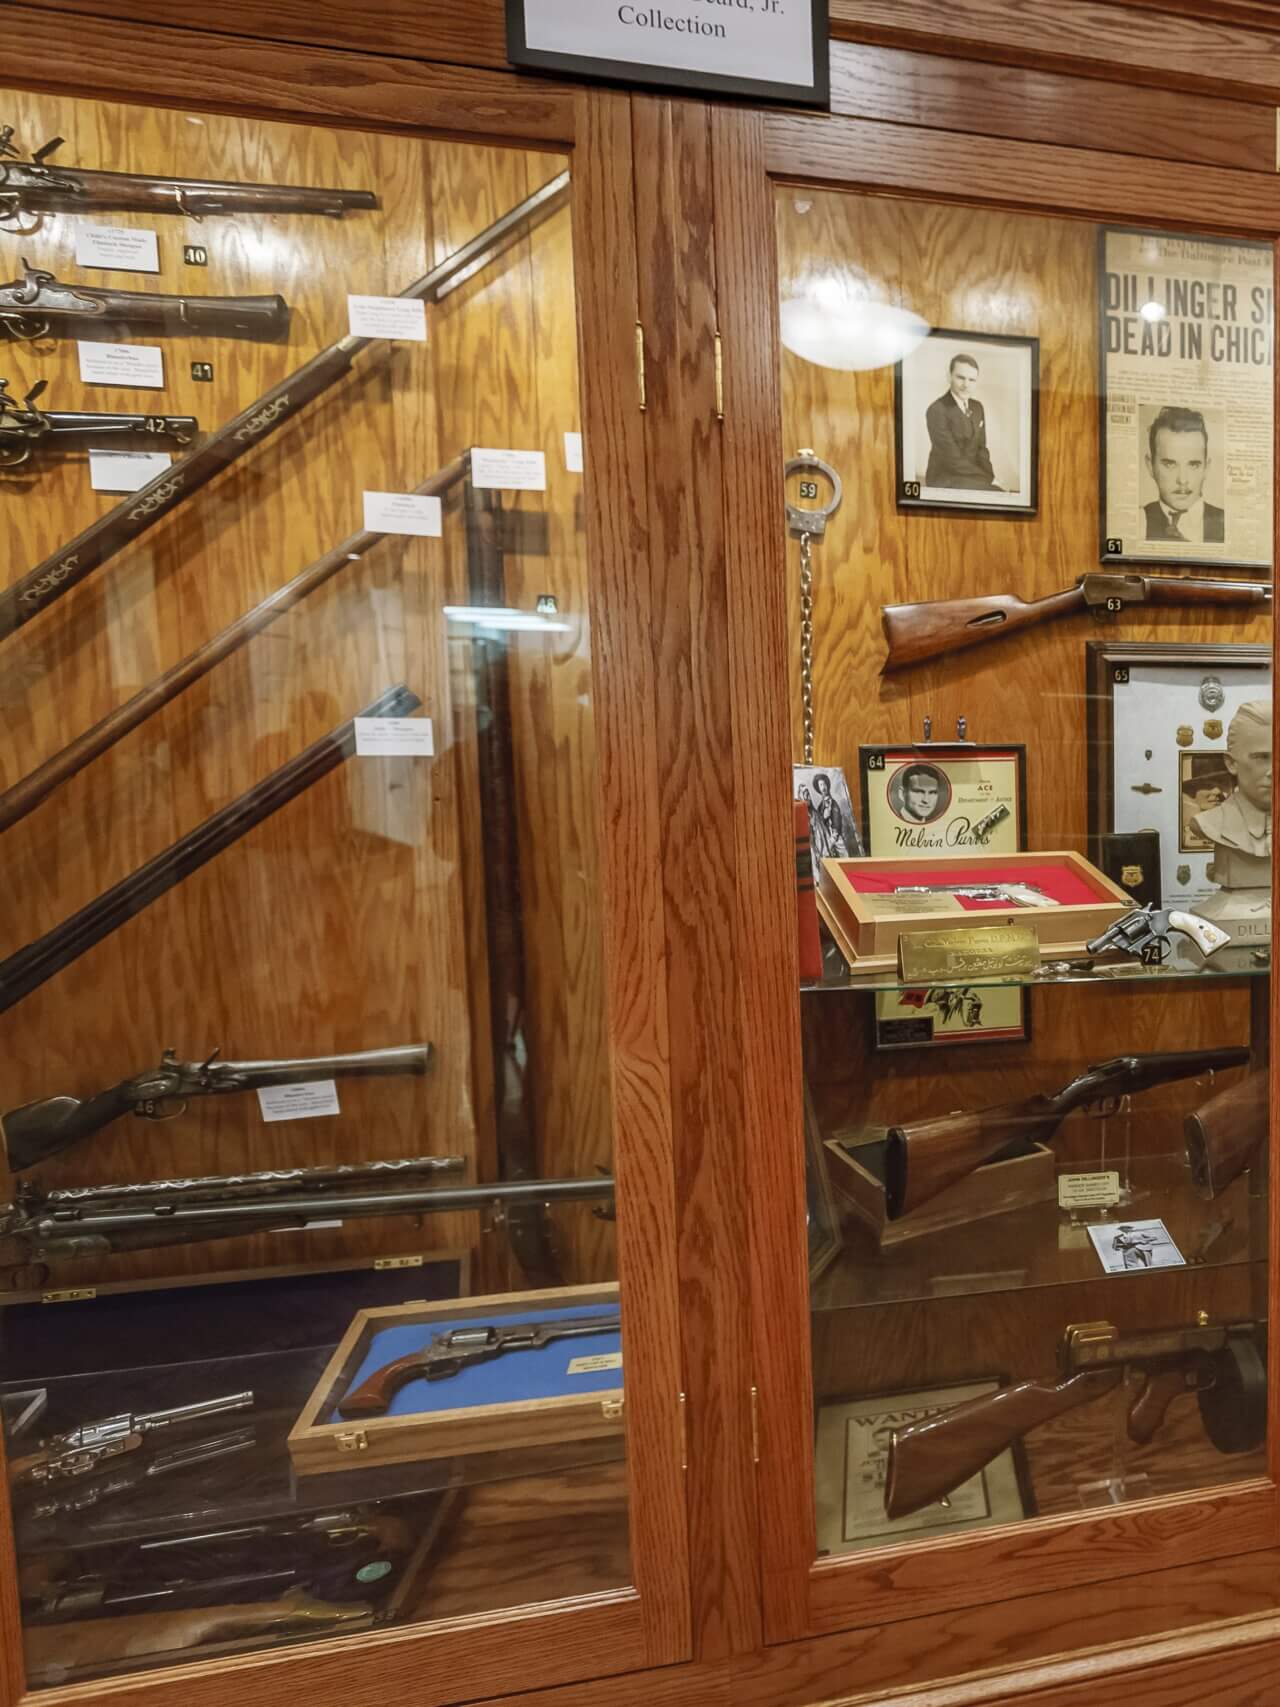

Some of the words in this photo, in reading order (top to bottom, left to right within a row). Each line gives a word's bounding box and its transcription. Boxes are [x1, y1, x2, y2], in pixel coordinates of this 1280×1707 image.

[761, 0, 785, 15] Jr.
[617, 4, 727, 38] Collection
[186, 248, 207, 264] 40
[1105, 314, 1172, 358] DEAD
[1179, 321, 1203, 360] IN
[1210, 323, 1272, 366] CHIC
[192, 363, 212, 379] 41
[145, 418, 166, 433] 42
[800, 483, 817, 498] 59
[904, 483, 919, 497] 60
[1107, 539, 1122, 552] 61
[1107, 599, 1121, 611] 63
[1114, 669, 1128, 682] 65
[868, 755, 883, 768] 64
[977, 784, 993, 792] ACE
[894, 825, 943, 849] Melvin
[946, 816, 992, 848] Purvis
[1143, 948, 1160, 963] 74
